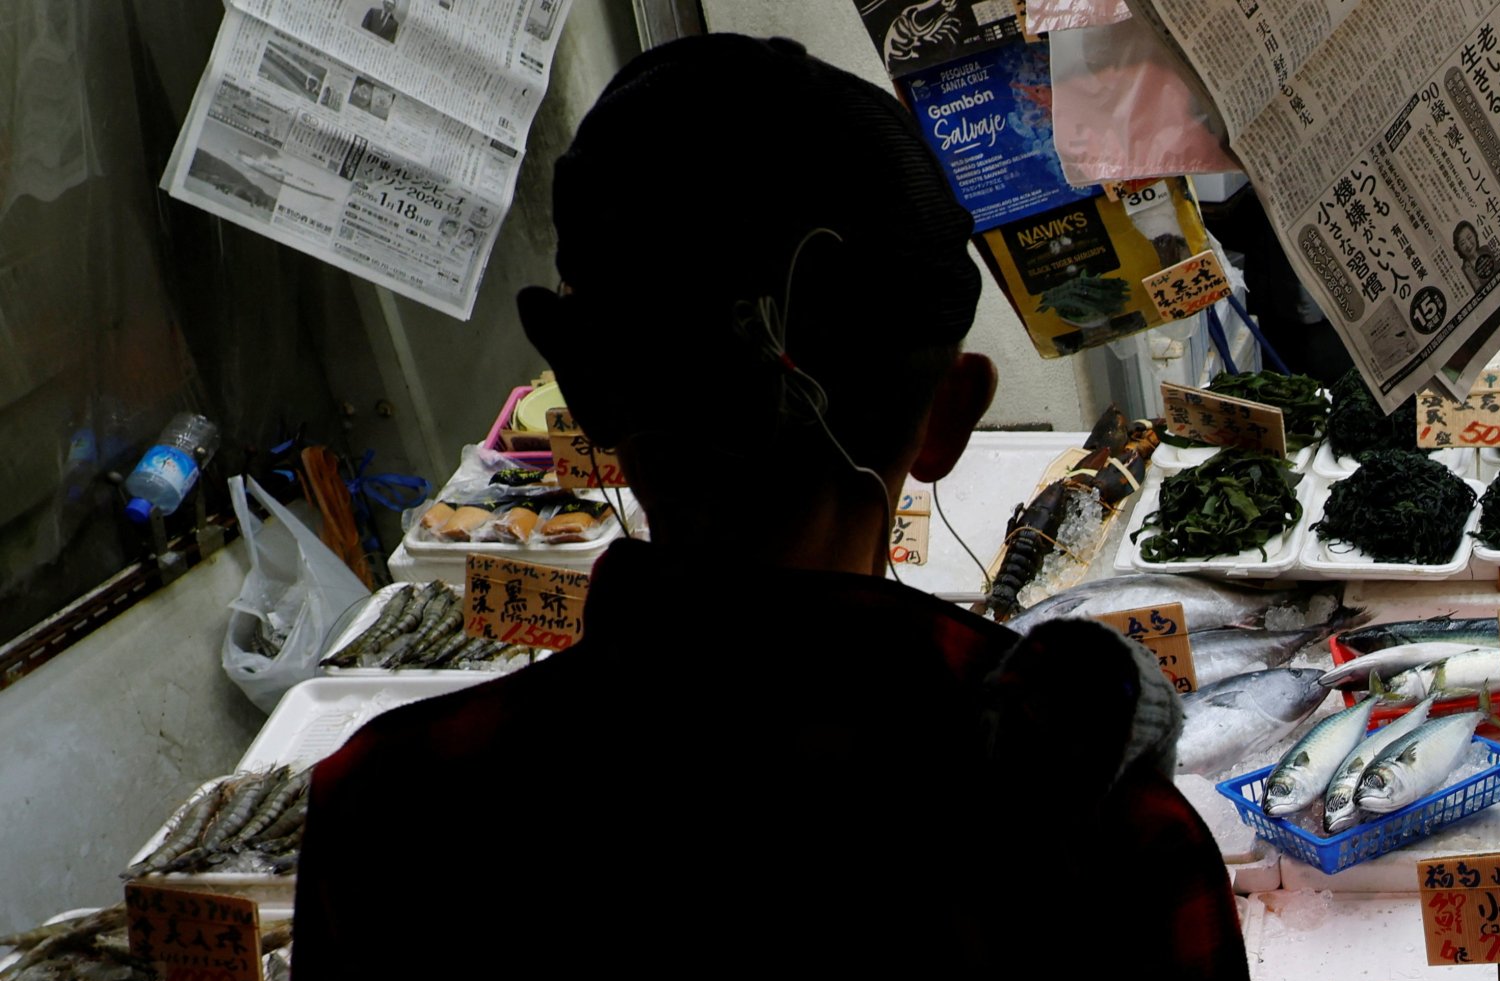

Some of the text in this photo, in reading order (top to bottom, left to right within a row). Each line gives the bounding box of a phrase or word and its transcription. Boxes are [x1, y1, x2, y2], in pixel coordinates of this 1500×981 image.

[939, 62, 981, 81] PESQUERA
[941, 70, 990, 95] SANTA CRUZ
[927, 89, 995, 119] Gambón
[933, 114, 1007, 151] Salvaje
[1129, 188, 1156, 206] 30
[1351, 160, 1390, 218] いつも
[1016, 211, 1088, 248] NAVIK'S
[1333, 176, 1411, 300] 機嫌がいい人の
[1317, 201, 1386, 304] 小さな習慣
[1413, 295, 1437, 324] 15
[1425, 861, 1481, 888] 福島
